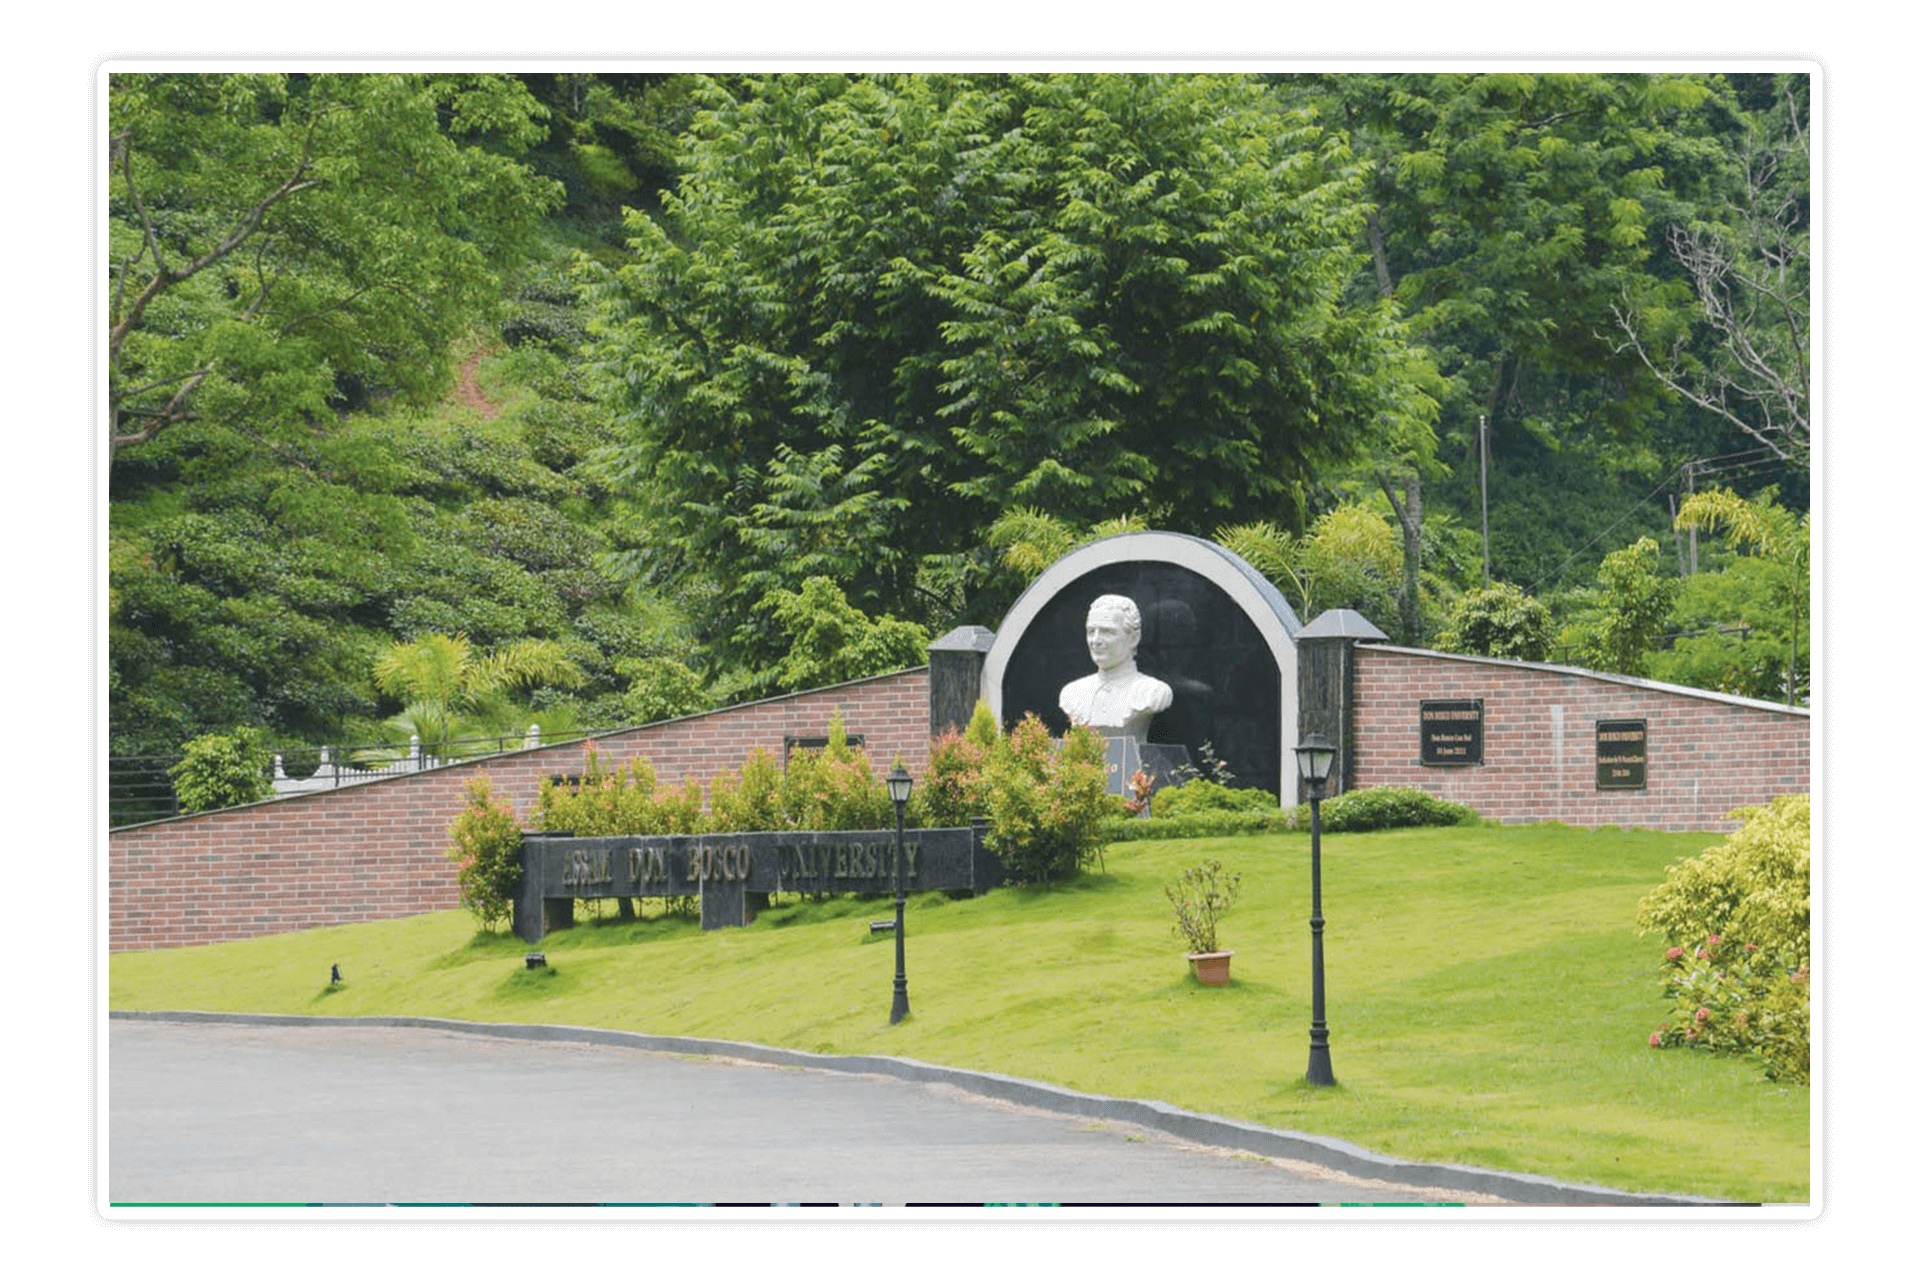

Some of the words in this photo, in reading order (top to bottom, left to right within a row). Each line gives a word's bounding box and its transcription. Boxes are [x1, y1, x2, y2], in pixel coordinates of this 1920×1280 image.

[562, 850, 611, 885] ASSAM
[629, 847, 667, 882] DON
[686, 844, 750, 882] BOSCO
